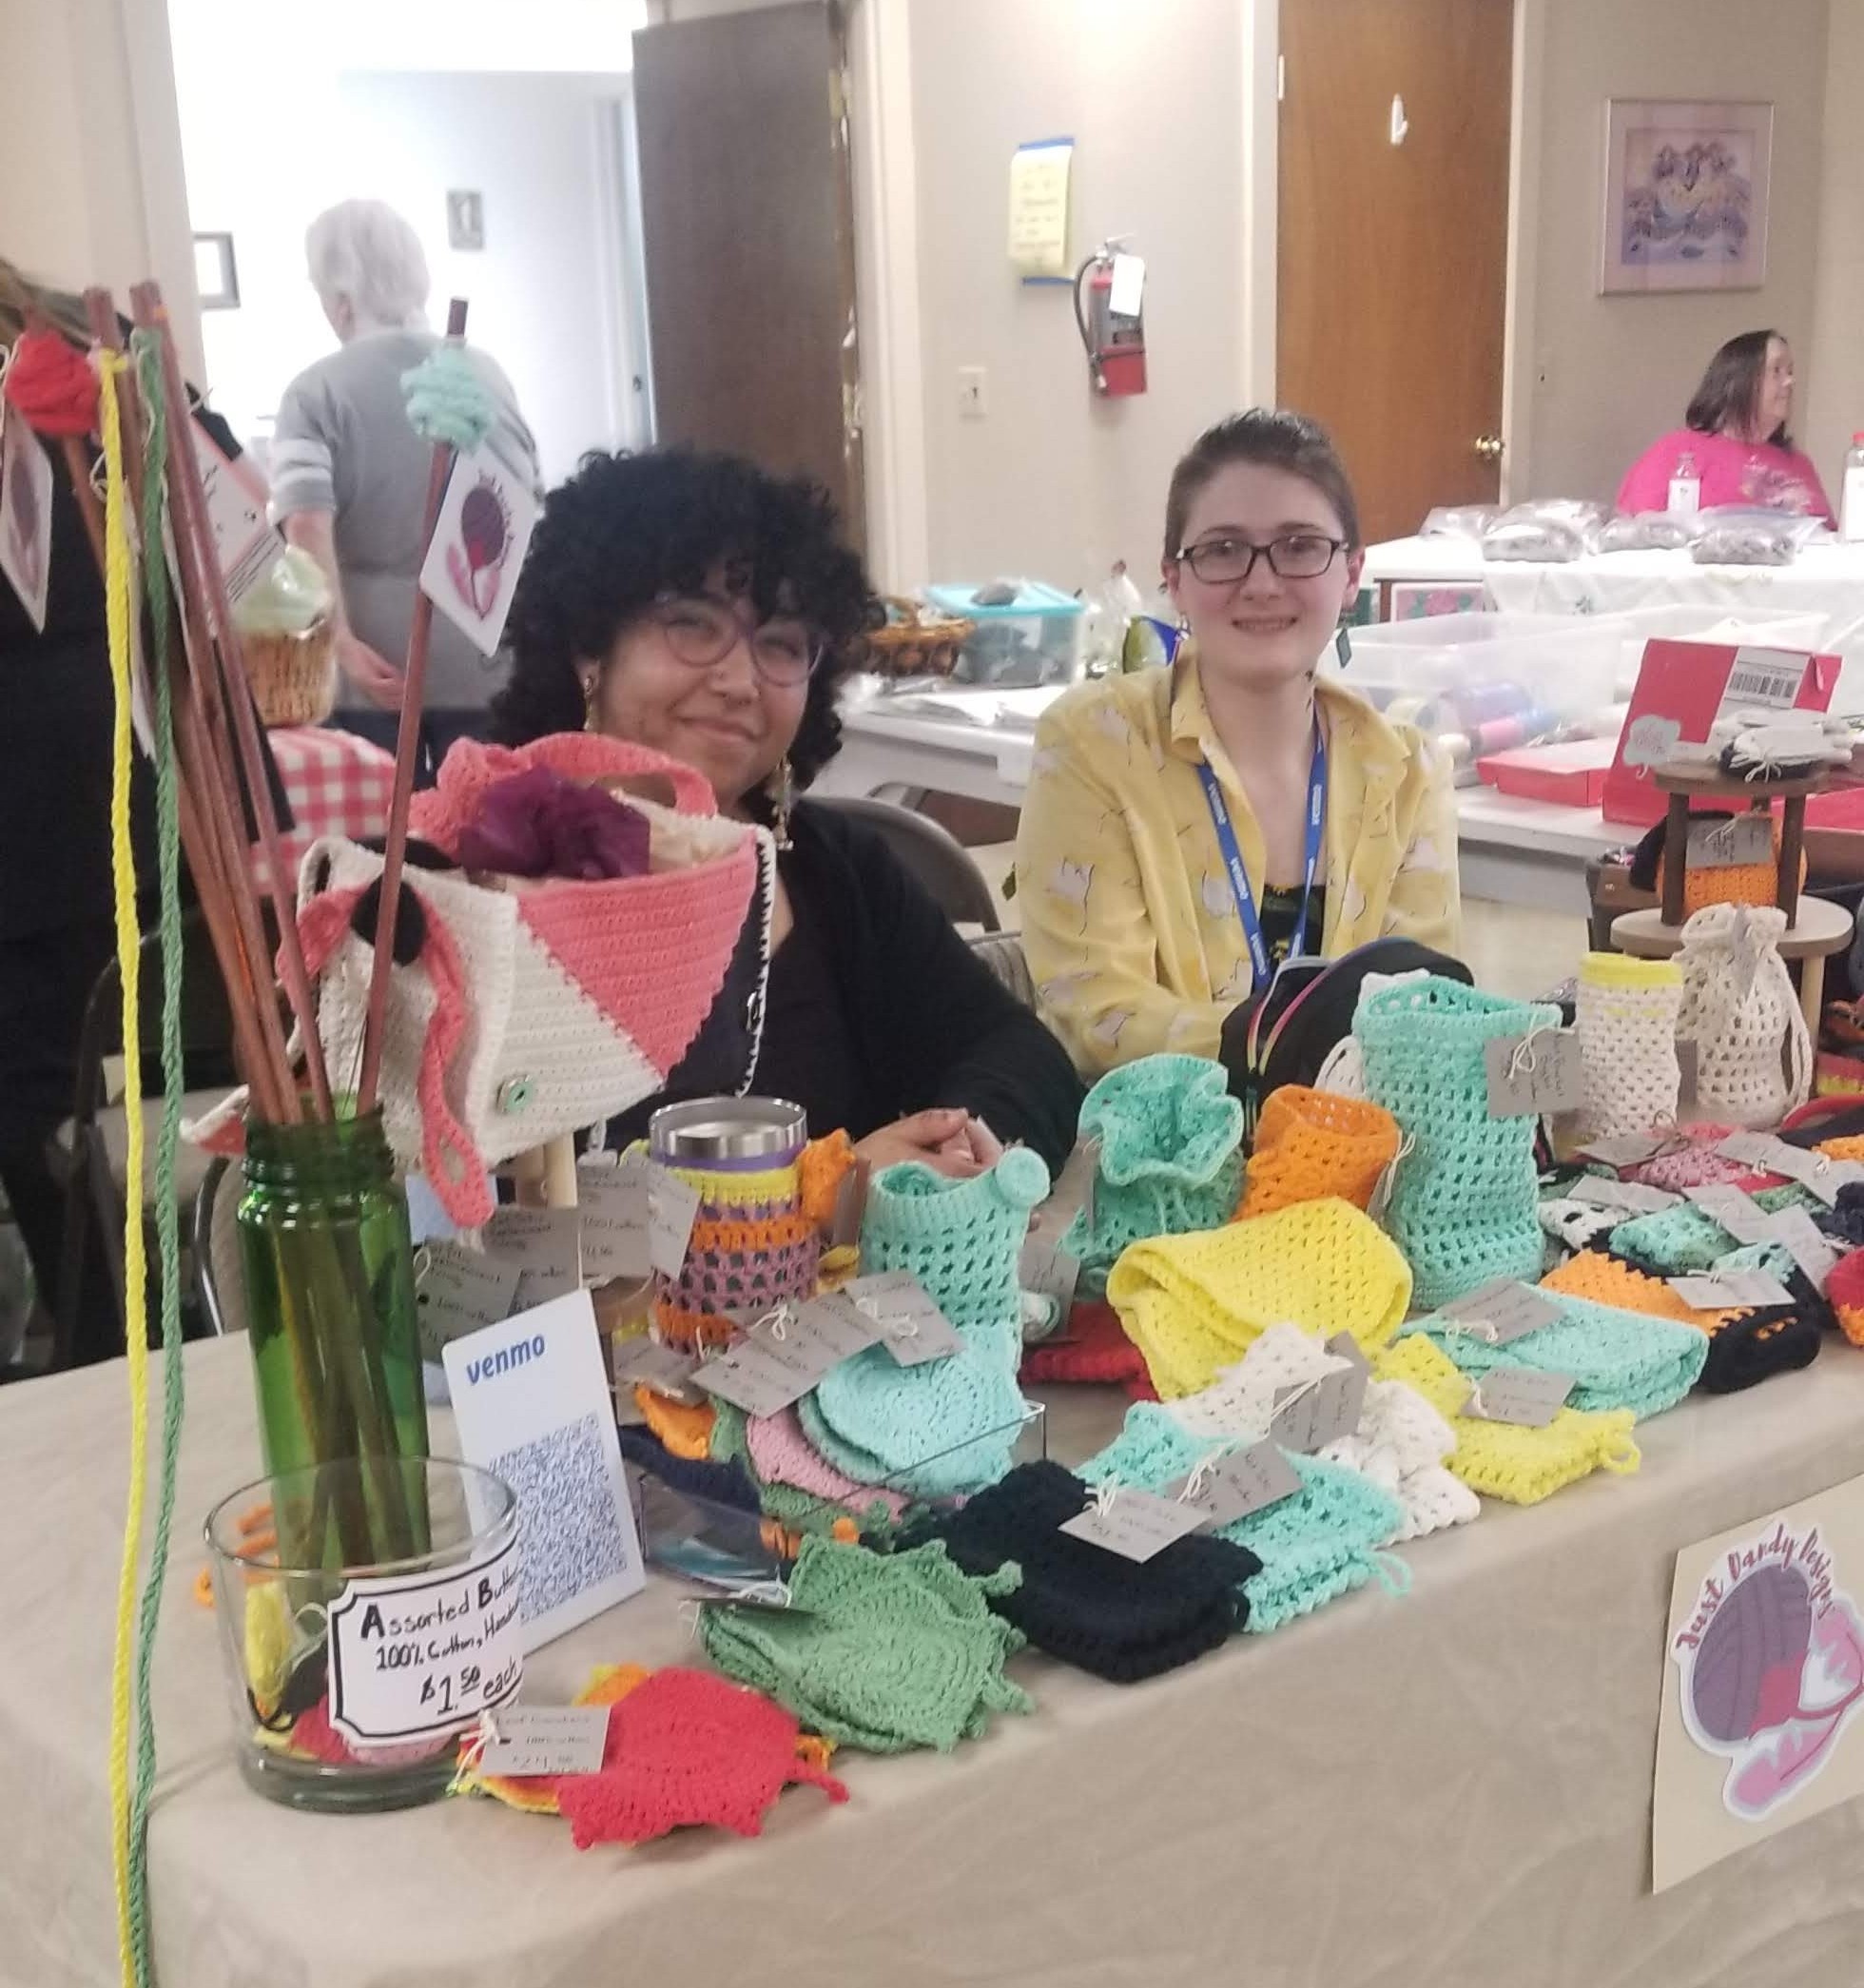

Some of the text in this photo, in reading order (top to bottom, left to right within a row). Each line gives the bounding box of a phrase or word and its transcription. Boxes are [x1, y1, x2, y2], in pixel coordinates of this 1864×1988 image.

[465, 1335, 546, 1386] venmo
[1676, 1578, 1724, 1649] Just
[1727, 1523, 1797, 1580] Dandy
[360, 1588, 470, 1639] Assorted
[483, 1656, 519, 1699] each
